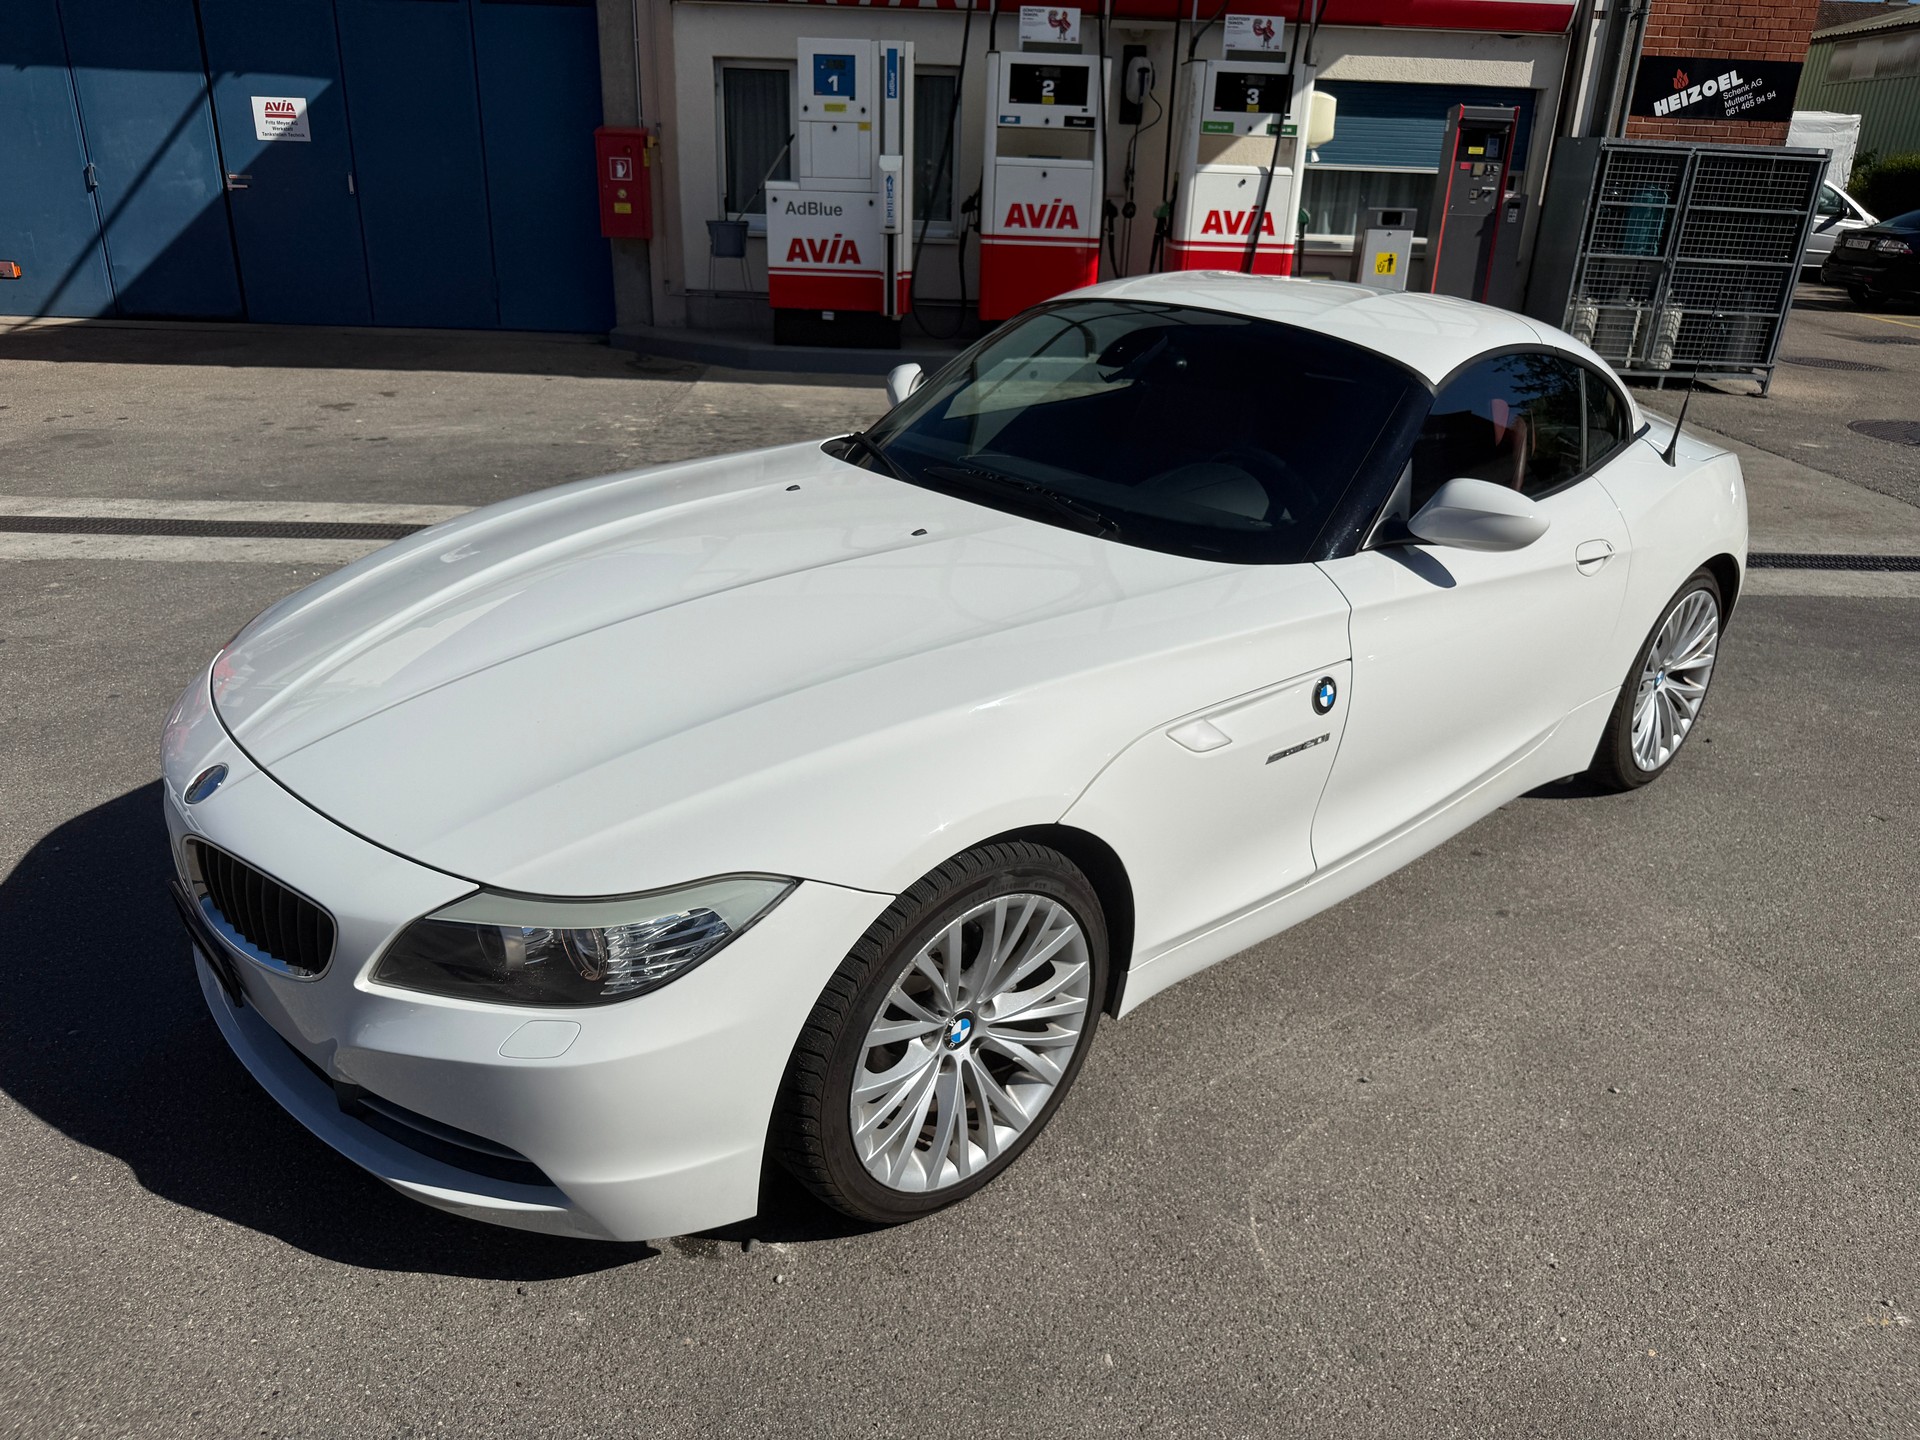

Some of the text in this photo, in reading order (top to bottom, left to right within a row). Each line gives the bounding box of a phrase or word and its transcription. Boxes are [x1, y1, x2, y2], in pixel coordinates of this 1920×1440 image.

[827, 75, 839, 92] 1
[1042, 80, 1055, 97] 2
[1722, 78, 1763, 100] Schenk AG
[1246, 88, 1259, 104] 3
[1653, 70, 1743, 116] HEIZOEL
[1724, 92, 1754, 109] Muttenz
[1725, 91, 1777, 117] 061 465 94 94
[785, 201, 843, 217] AdBlue
